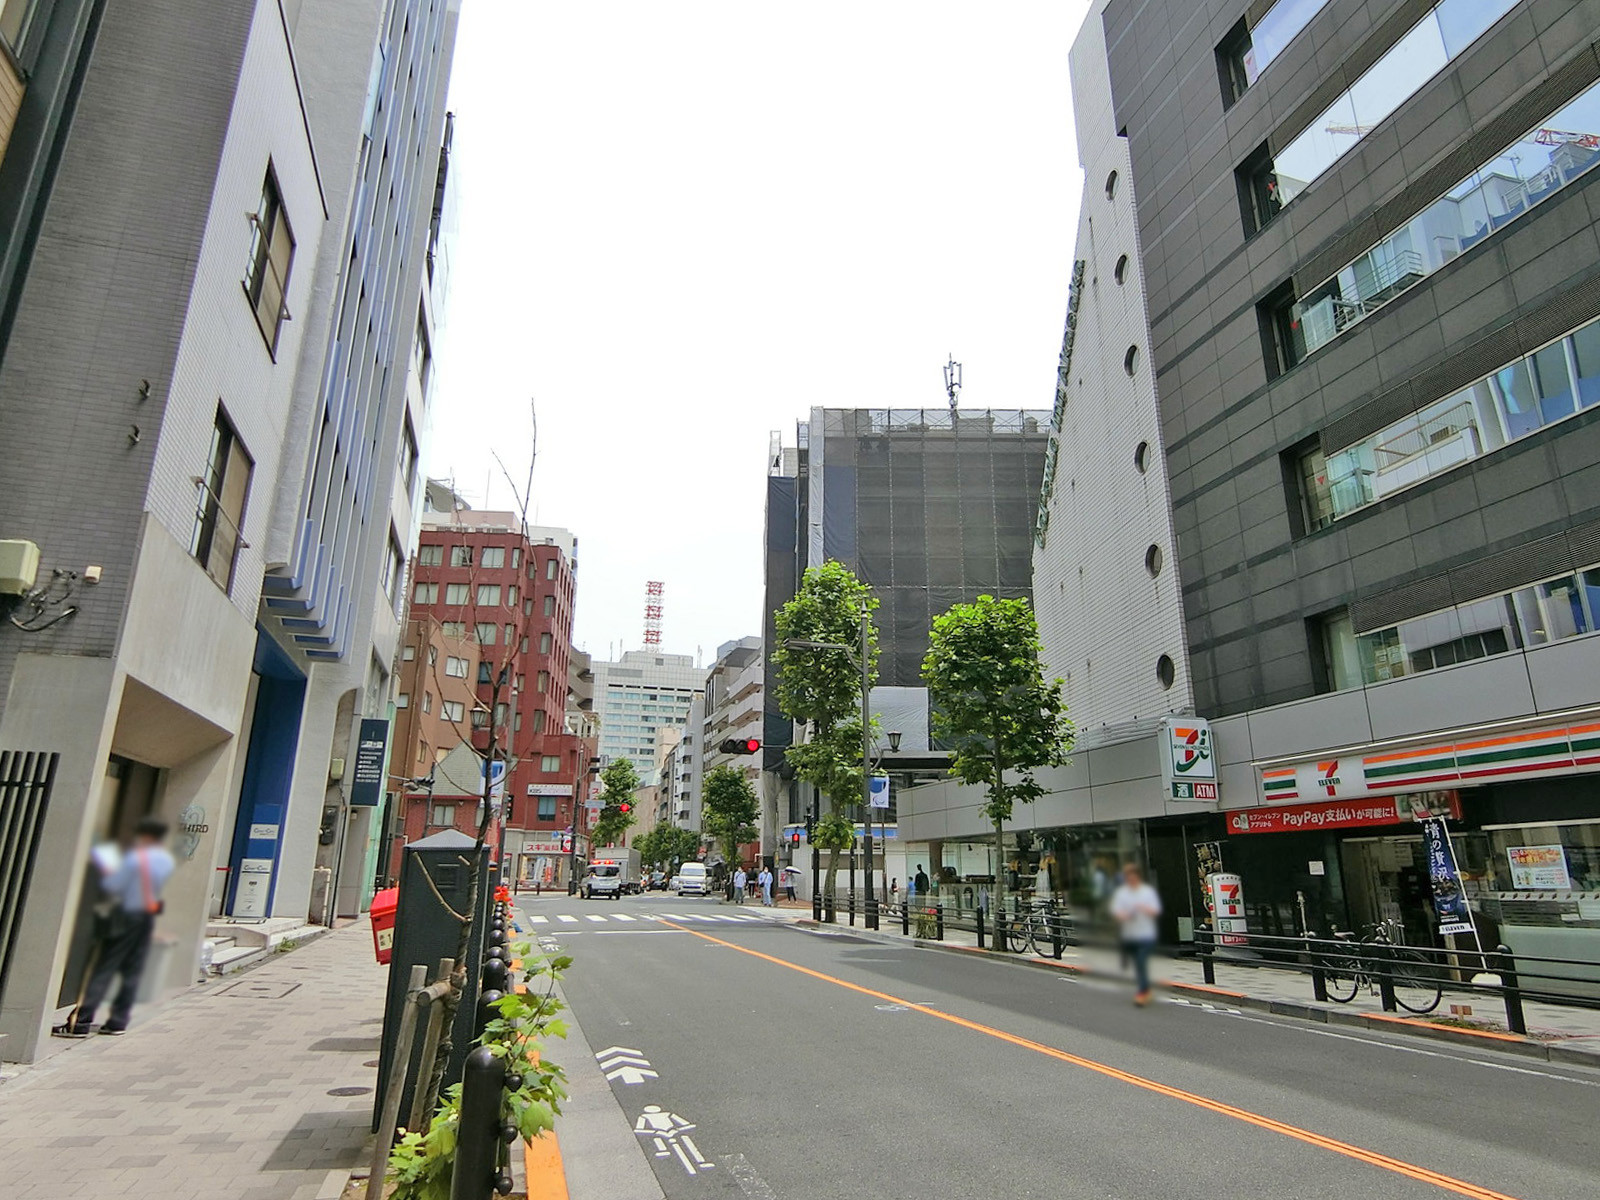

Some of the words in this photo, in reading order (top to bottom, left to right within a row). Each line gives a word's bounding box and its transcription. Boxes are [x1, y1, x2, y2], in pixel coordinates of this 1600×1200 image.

[1058, 260, 1085, 386] Akasaka
[1177, 784, 1189, 797] 酒
[1197, 785, 1214, 798] ATM
